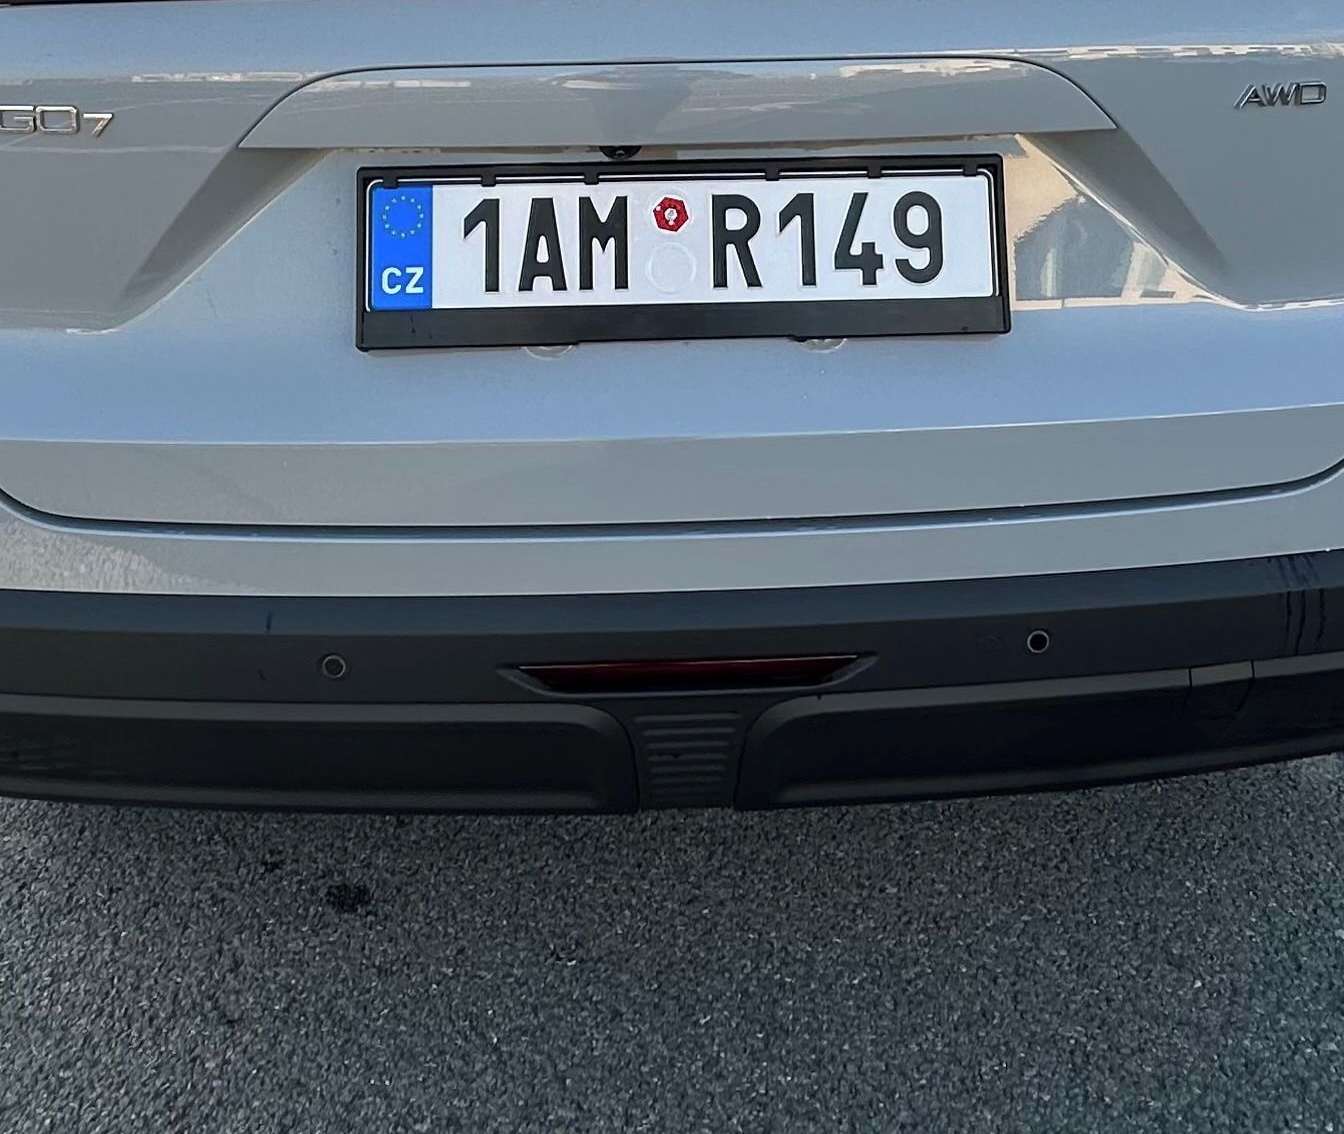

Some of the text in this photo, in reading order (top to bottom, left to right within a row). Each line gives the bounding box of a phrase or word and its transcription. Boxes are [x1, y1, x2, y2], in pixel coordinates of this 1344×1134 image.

[1233, 81, 1327, 109] AWD
[83, 113, 114, 137] 7
[463, 190, 944, 293] 1AM R149
[380, 266, 425, 295] CZ
